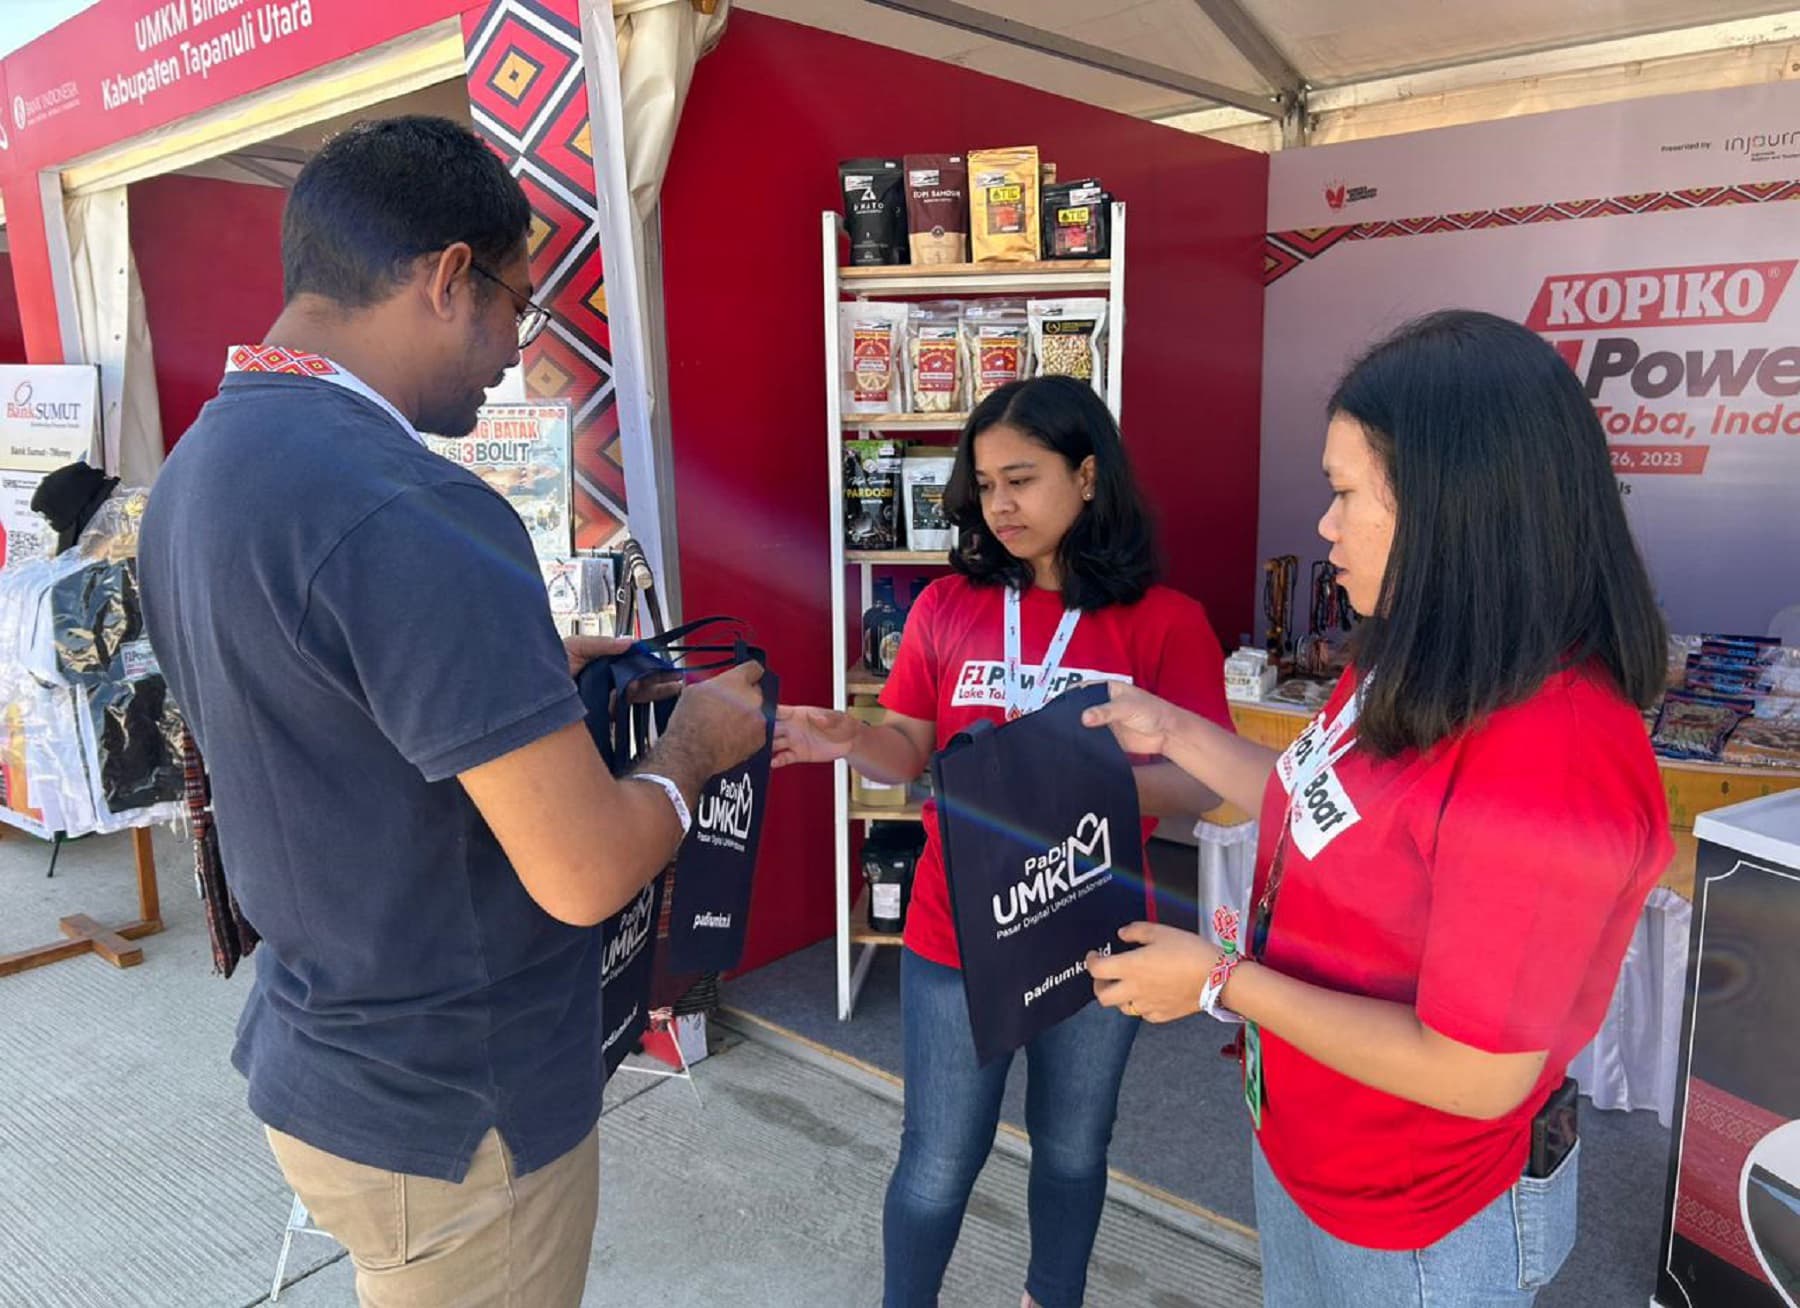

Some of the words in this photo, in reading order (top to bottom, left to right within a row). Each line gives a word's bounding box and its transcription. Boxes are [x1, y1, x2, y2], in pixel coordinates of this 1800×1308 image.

[135, 0, 188, 51] UMKM
[190, 0, 245, 27] Bina
[101, 54, 181, 111] Kabupaten
[180, 12, 256, 80] Tapanuli
[257, 0, 313, 44] Utara
[1546, 269, 1765, 326] KOPIKO
[493, 420, 539, 440] BATAK
[1640, 450, 1684, 467] 2023
[958, 688, 985, 700] Lake
[1025, 841, 1067, 876] PaDi
[996, 923, 1021, 940] Pasar
[1023, 905, 1050, 928] Digital
